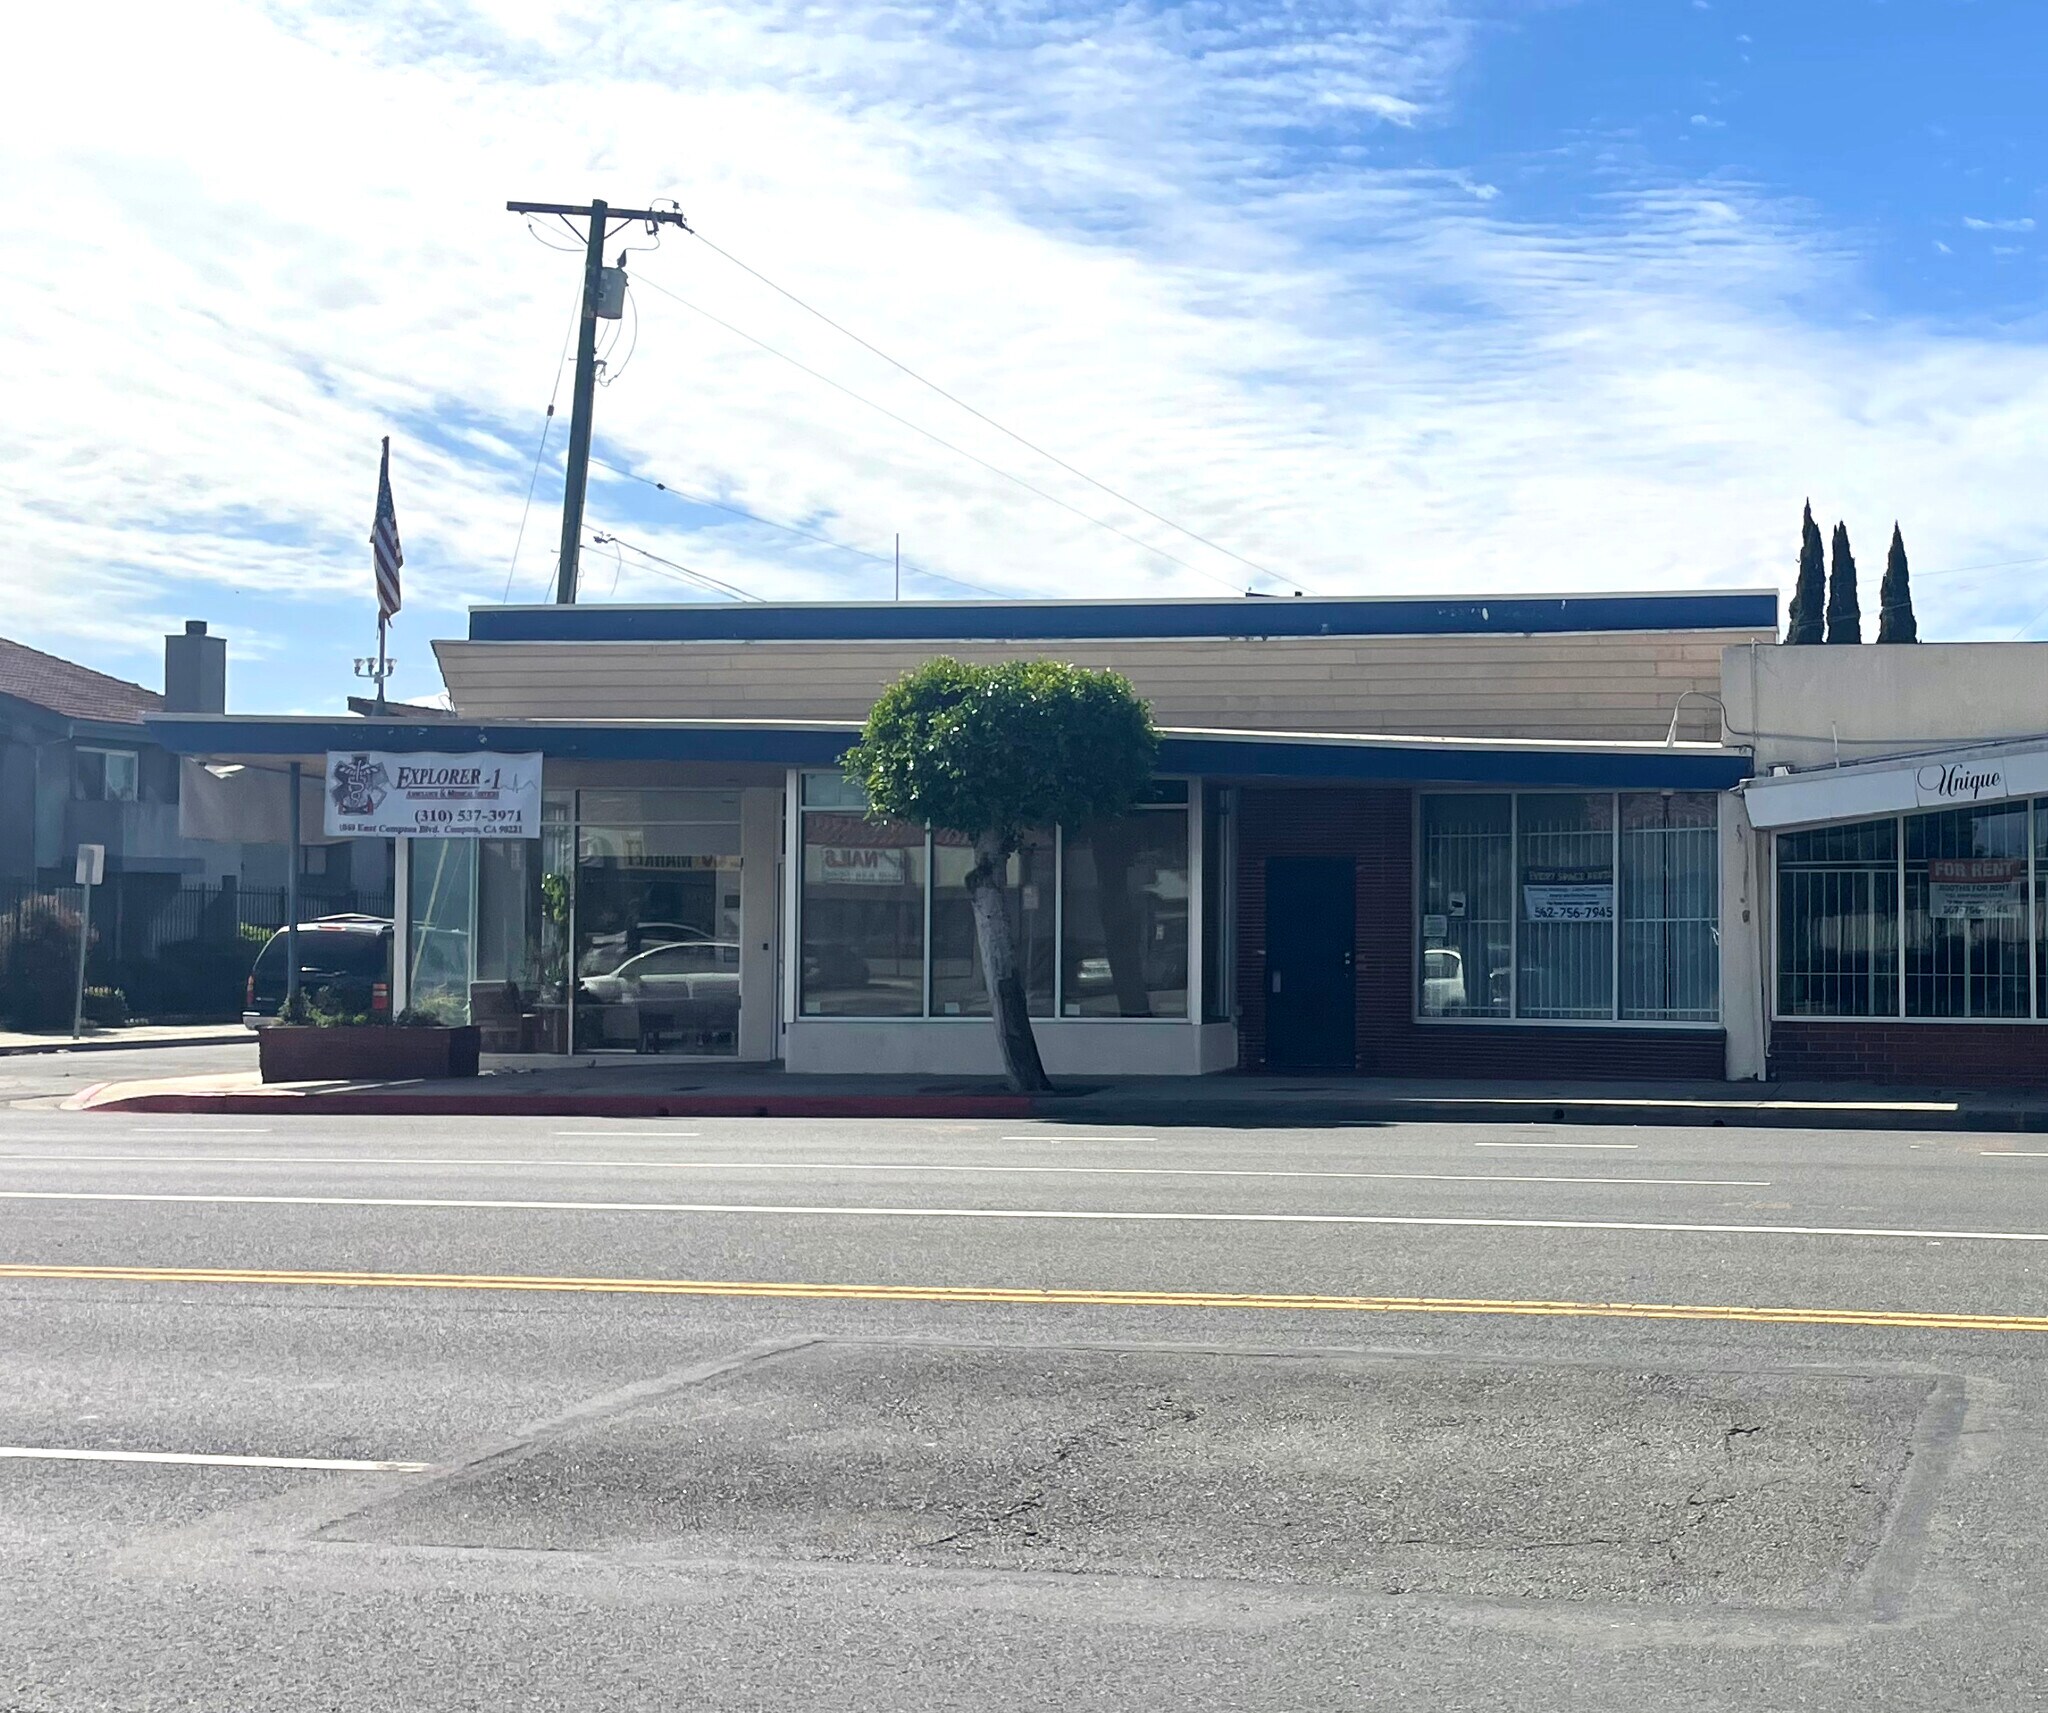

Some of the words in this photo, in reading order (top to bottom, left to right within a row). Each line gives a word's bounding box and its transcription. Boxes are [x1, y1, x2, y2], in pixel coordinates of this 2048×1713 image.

[397, 766, 481, 790] EXPLORER
[1917, 764, 2001, 799] Unique
[415, 809, 453, 824] (310)
[457, 809, 522, 823] 537-3971
[483, 825, 497, 834] CA
[1934, 862, 1967, 877] FOR
[1970, 862, 2014, 877] RENT
[1534, 906, 1613, 918] 562-756-7945
